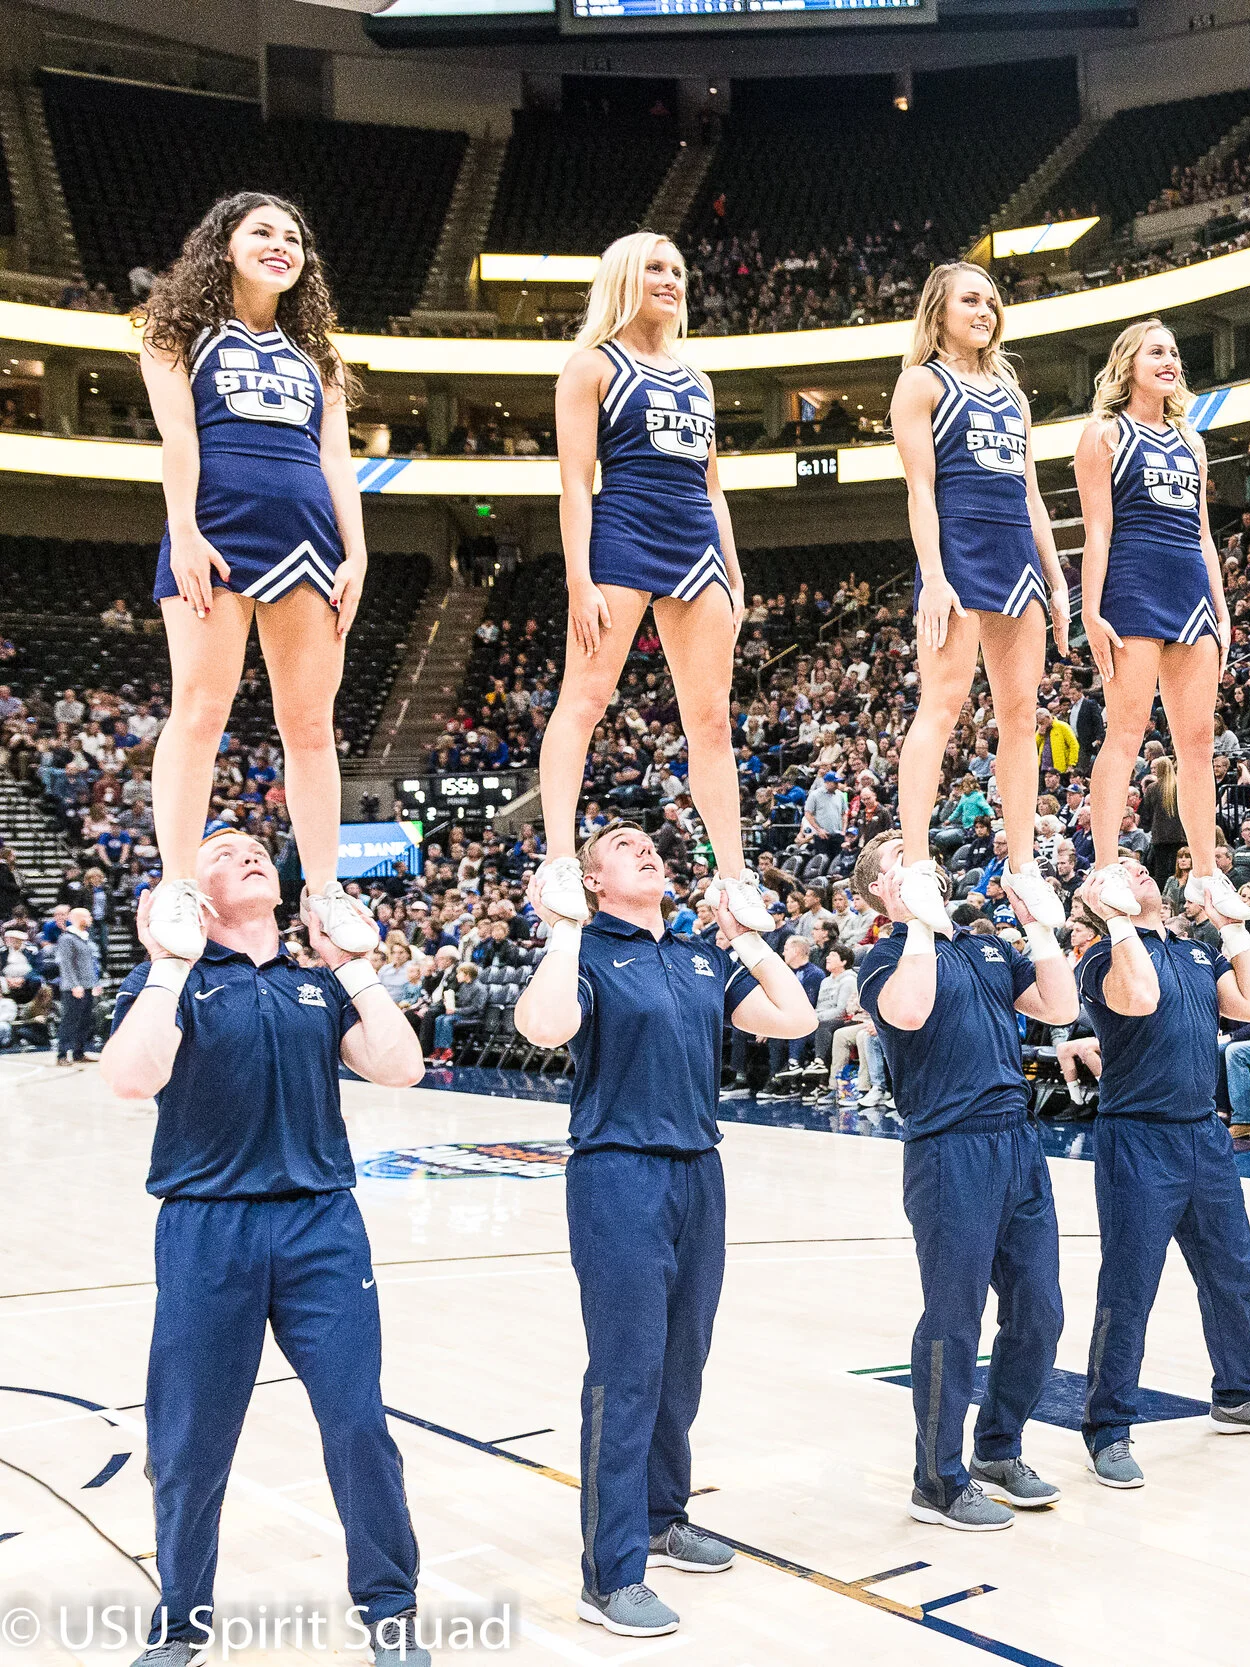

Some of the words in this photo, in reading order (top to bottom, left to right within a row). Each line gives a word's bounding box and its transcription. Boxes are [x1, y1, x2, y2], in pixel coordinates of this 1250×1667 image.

[214, 369, 316, 409] STATE
[645, 407, 716, 445] STATE
[1142, 467, 1202, 495] STATE
